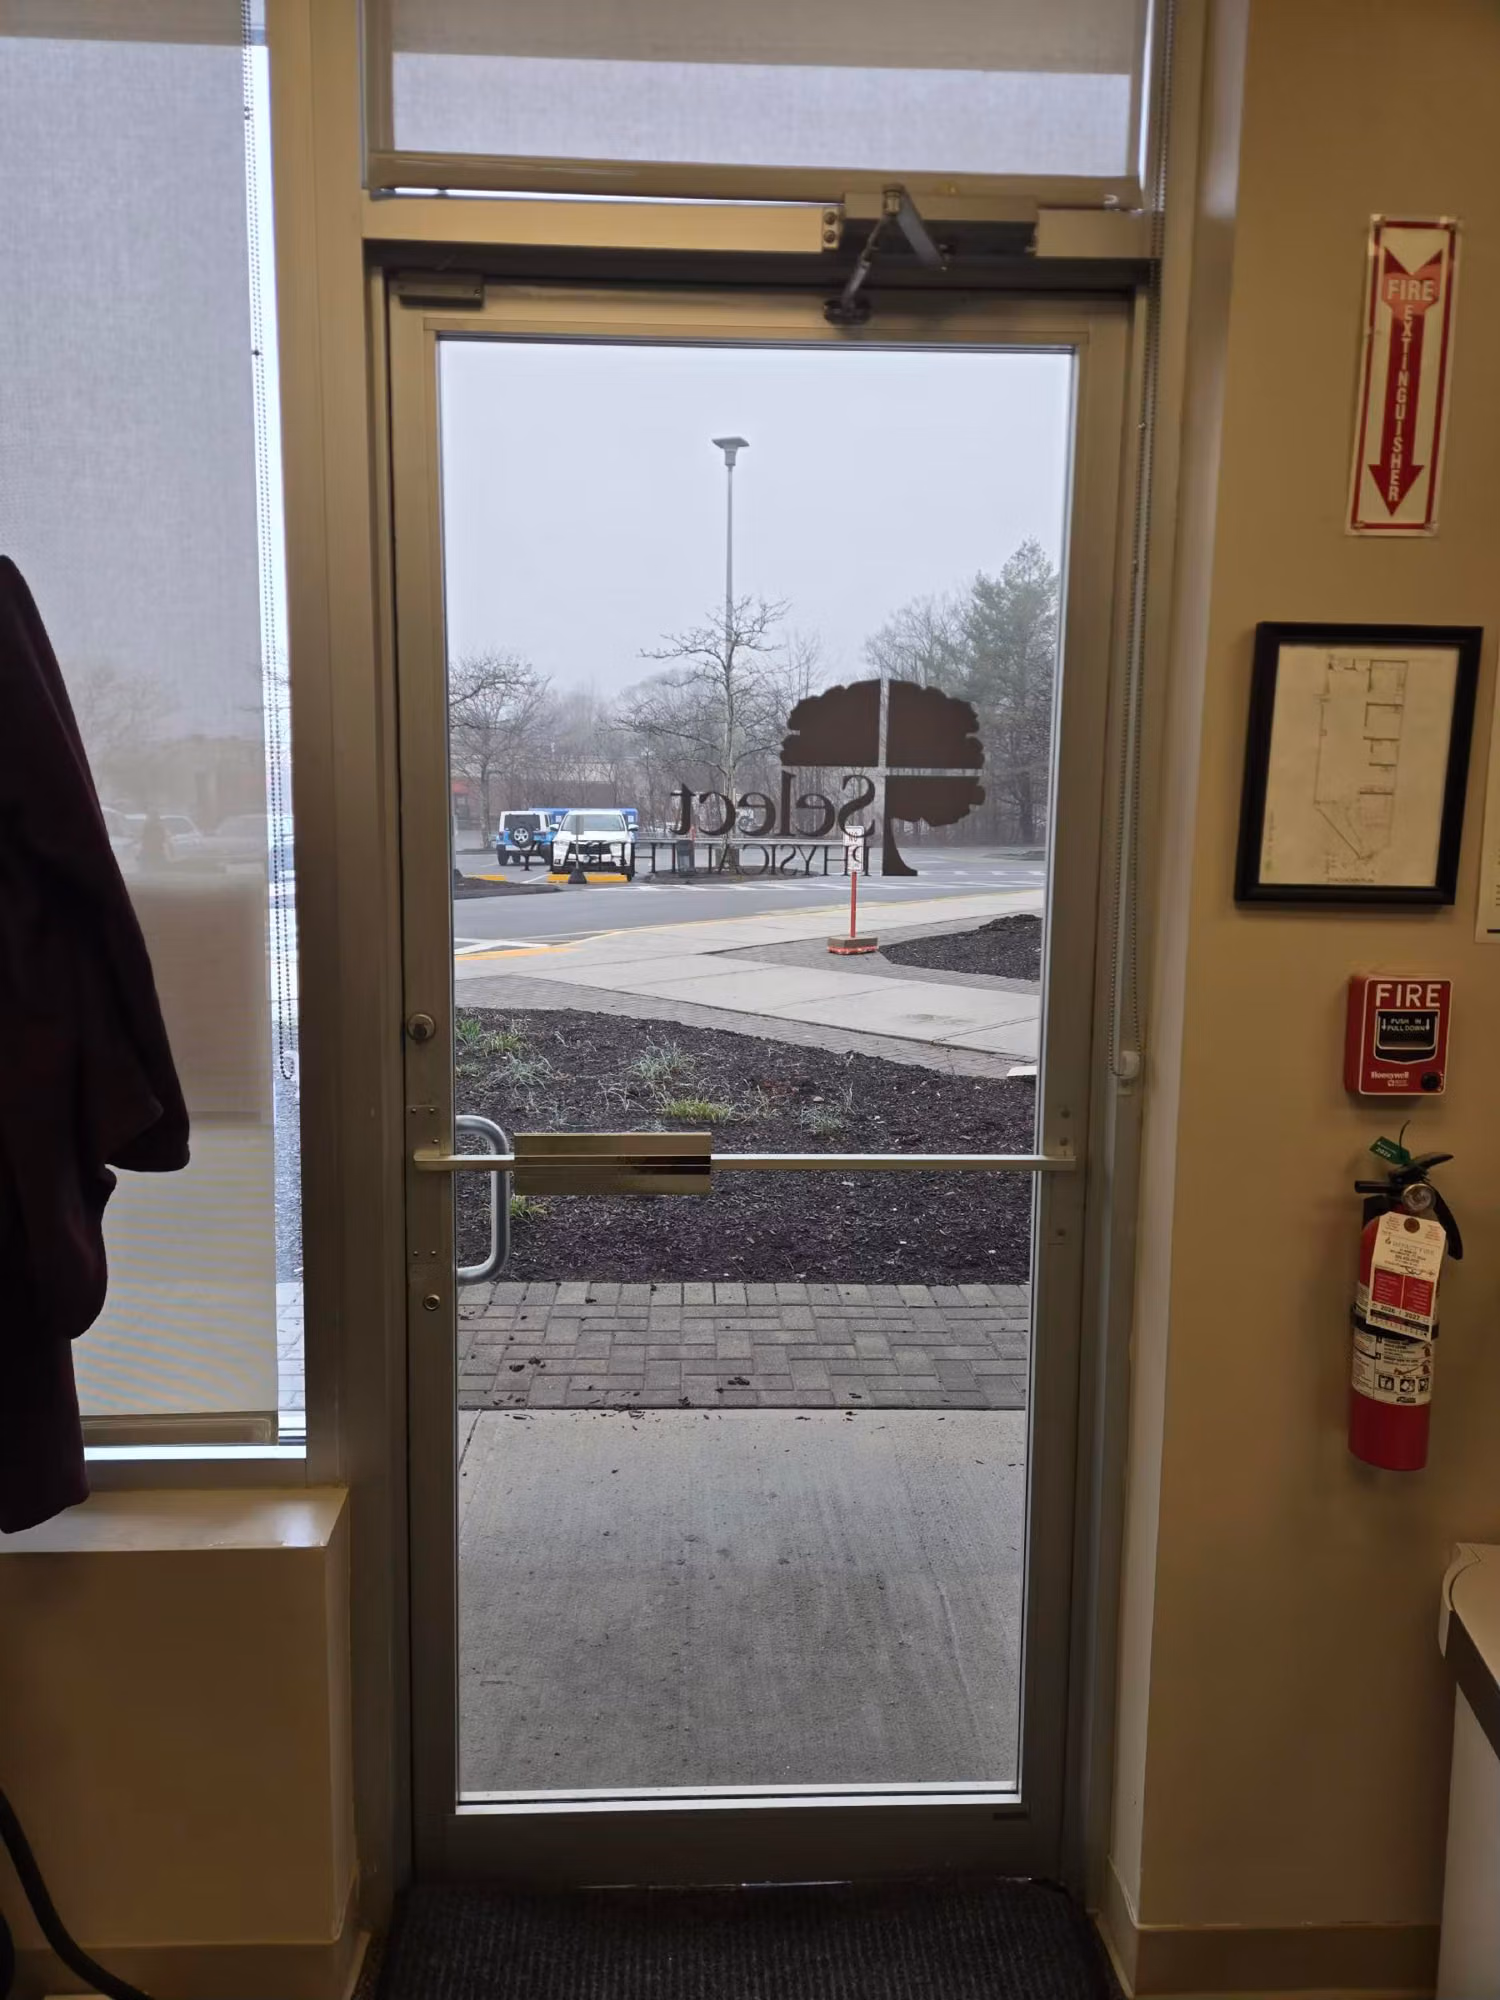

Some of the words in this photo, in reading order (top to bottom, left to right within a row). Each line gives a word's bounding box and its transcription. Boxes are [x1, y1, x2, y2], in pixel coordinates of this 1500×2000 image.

[1387, 279, 1434, 301] FIRE
[1388, 304, 1414, 502] EXTINGUISHER
[1376, 984, 1441, 1007] FIRE
[1371, 1071, 1409, 1080] Honeywell
